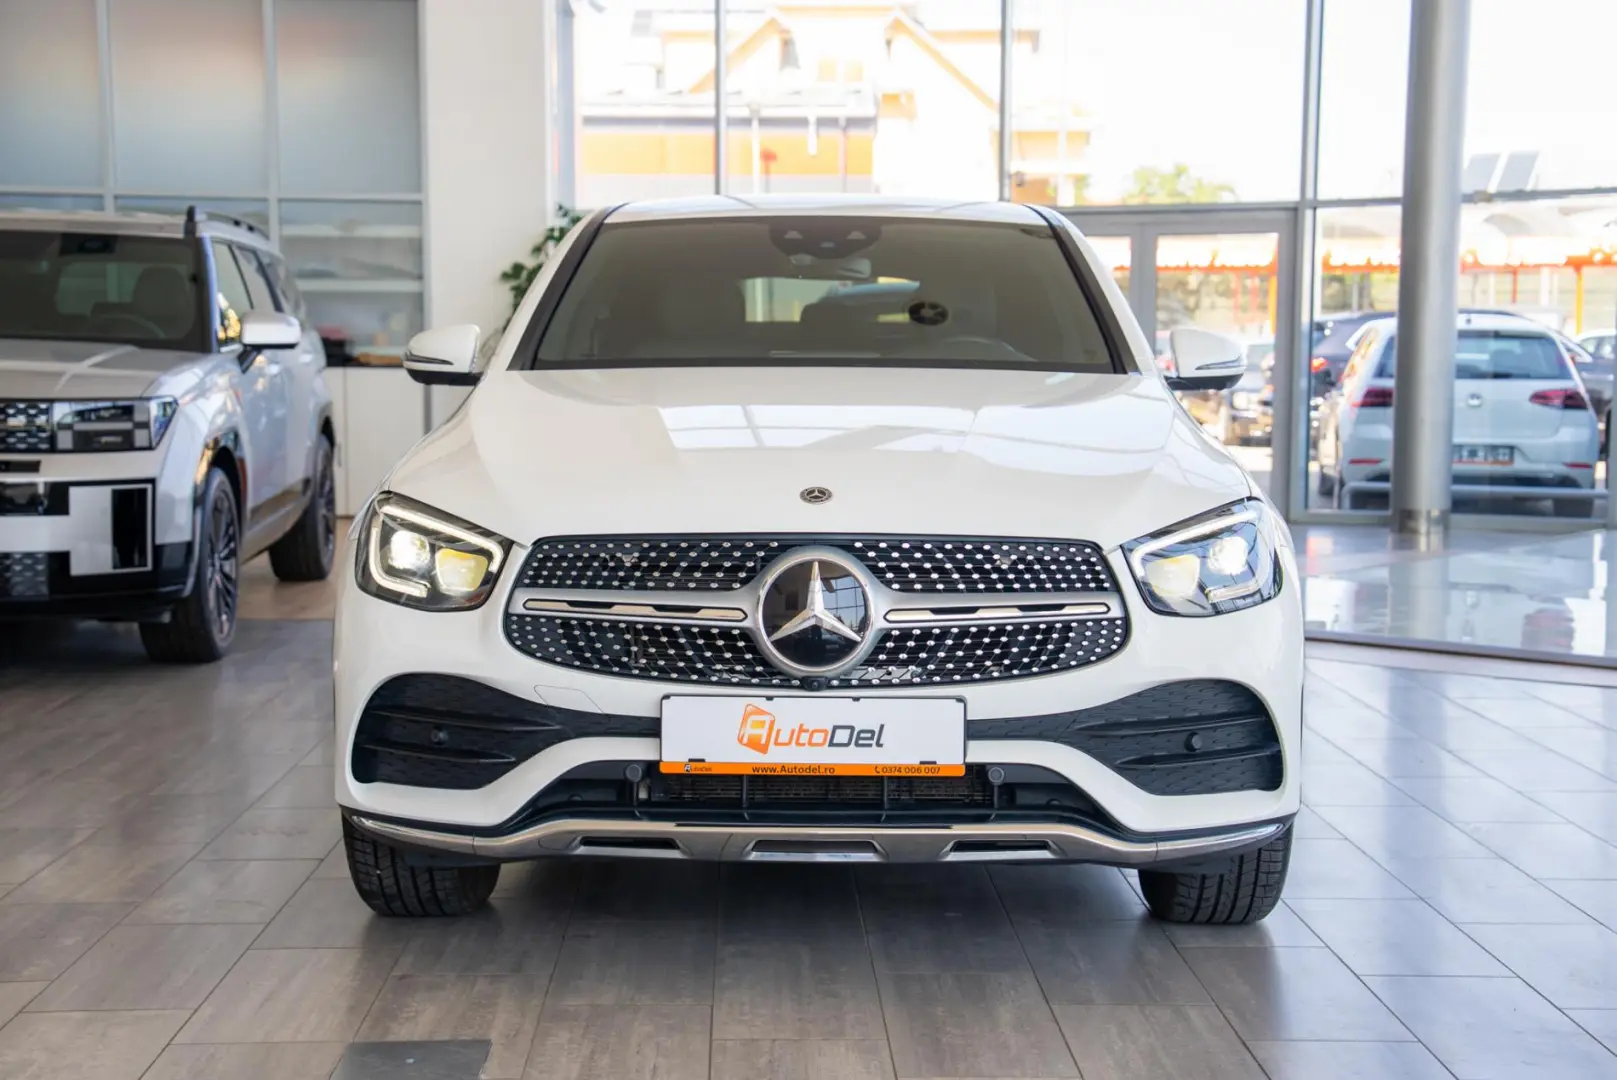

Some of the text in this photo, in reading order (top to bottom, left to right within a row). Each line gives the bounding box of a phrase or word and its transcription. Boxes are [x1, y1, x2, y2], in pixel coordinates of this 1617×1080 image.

[740, 711, 885, 749] AutoDel
[752, 765, 835, 774] www.Autodel.ro
[882, 766, 941, 774] 0374 006 007
